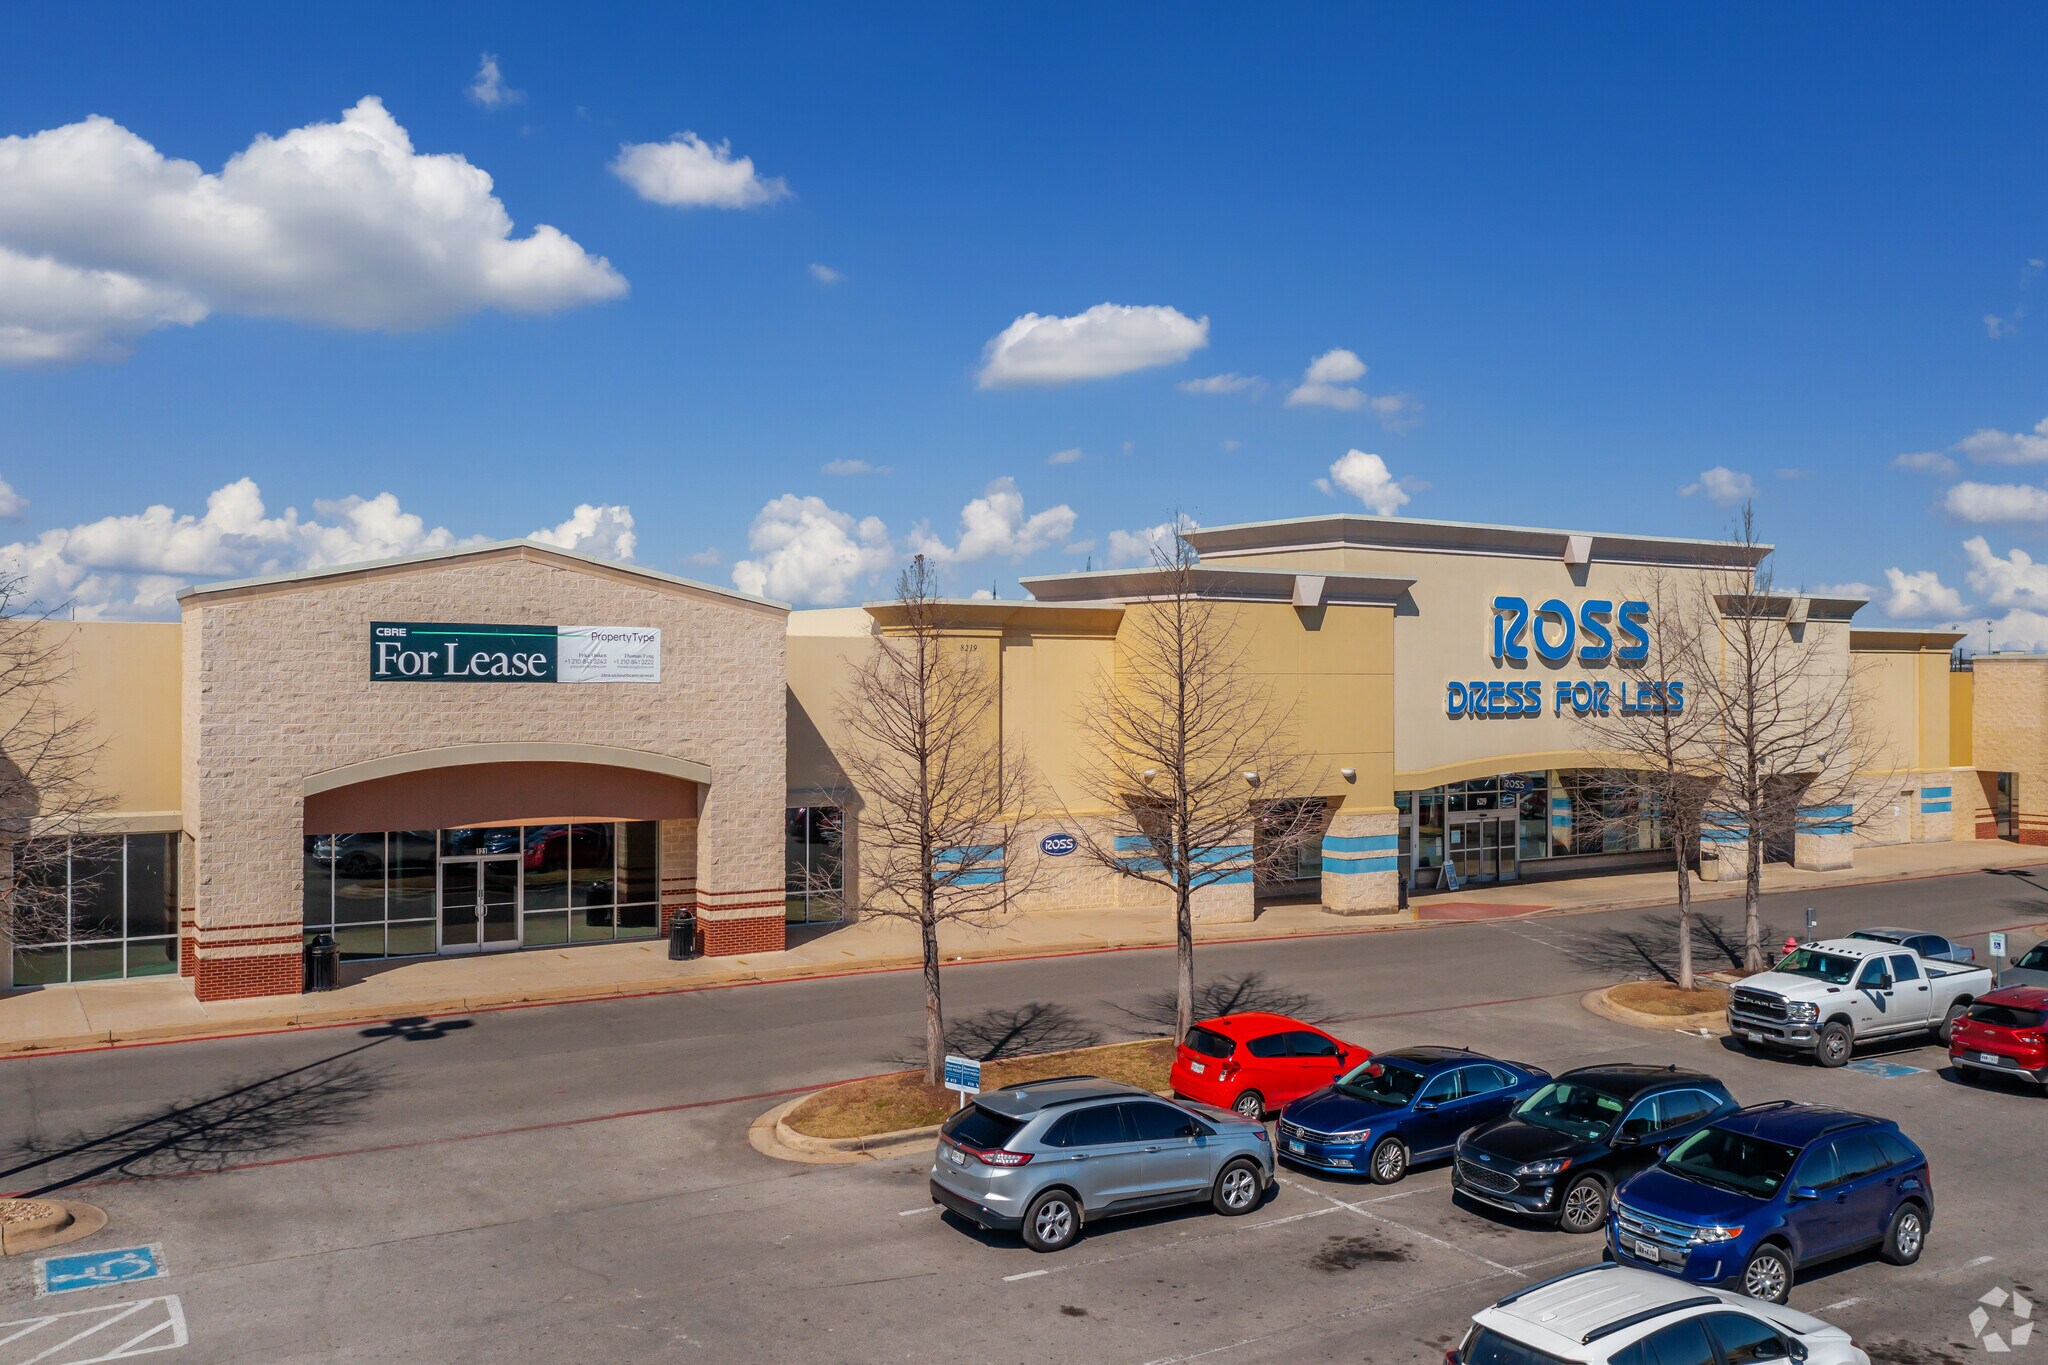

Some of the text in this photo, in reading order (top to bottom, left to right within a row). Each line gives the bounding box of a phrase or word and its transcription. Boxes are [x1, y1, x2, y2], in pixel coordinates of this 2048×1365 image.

[376, 627, 407, 637] CBRE
[1492, 596, 1650, 660] ROSS
[591, 631, 655, 643] PropertyType
[960, 644, 978, 652] 8219
[375, 641, 547, 677] For Lease
[1447, 680, 1684, 714] DRESS FOR LESS
[1504, 779, 1525, 789] ROSS
[1045, 839, 1074, 850] ROSS
